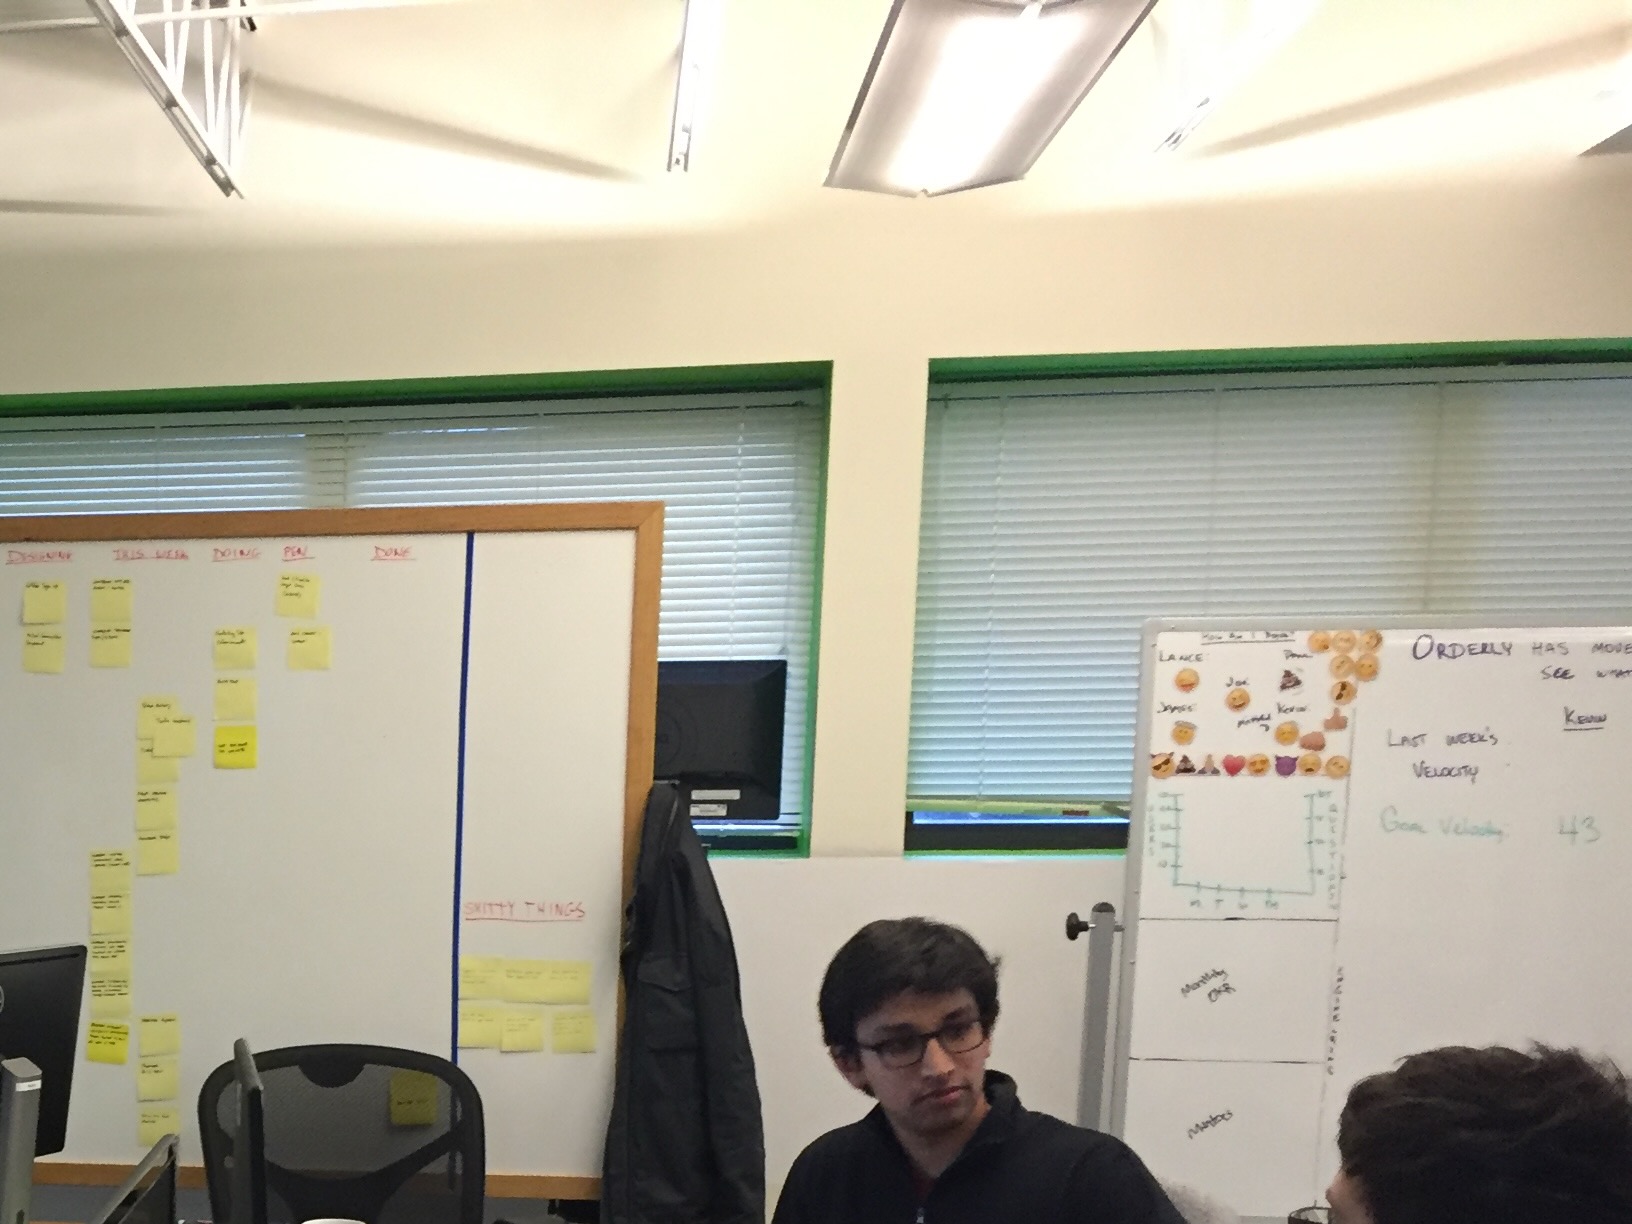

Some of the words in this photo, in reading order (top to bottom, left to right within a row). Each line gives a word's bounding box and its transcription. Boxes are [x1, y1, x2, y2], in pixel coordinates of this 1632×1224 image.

[1531, 641, 1569, 656] HAS
[1541, 665, 1575, 680] SEE
[1387, 729, 1428, 747] LAST
